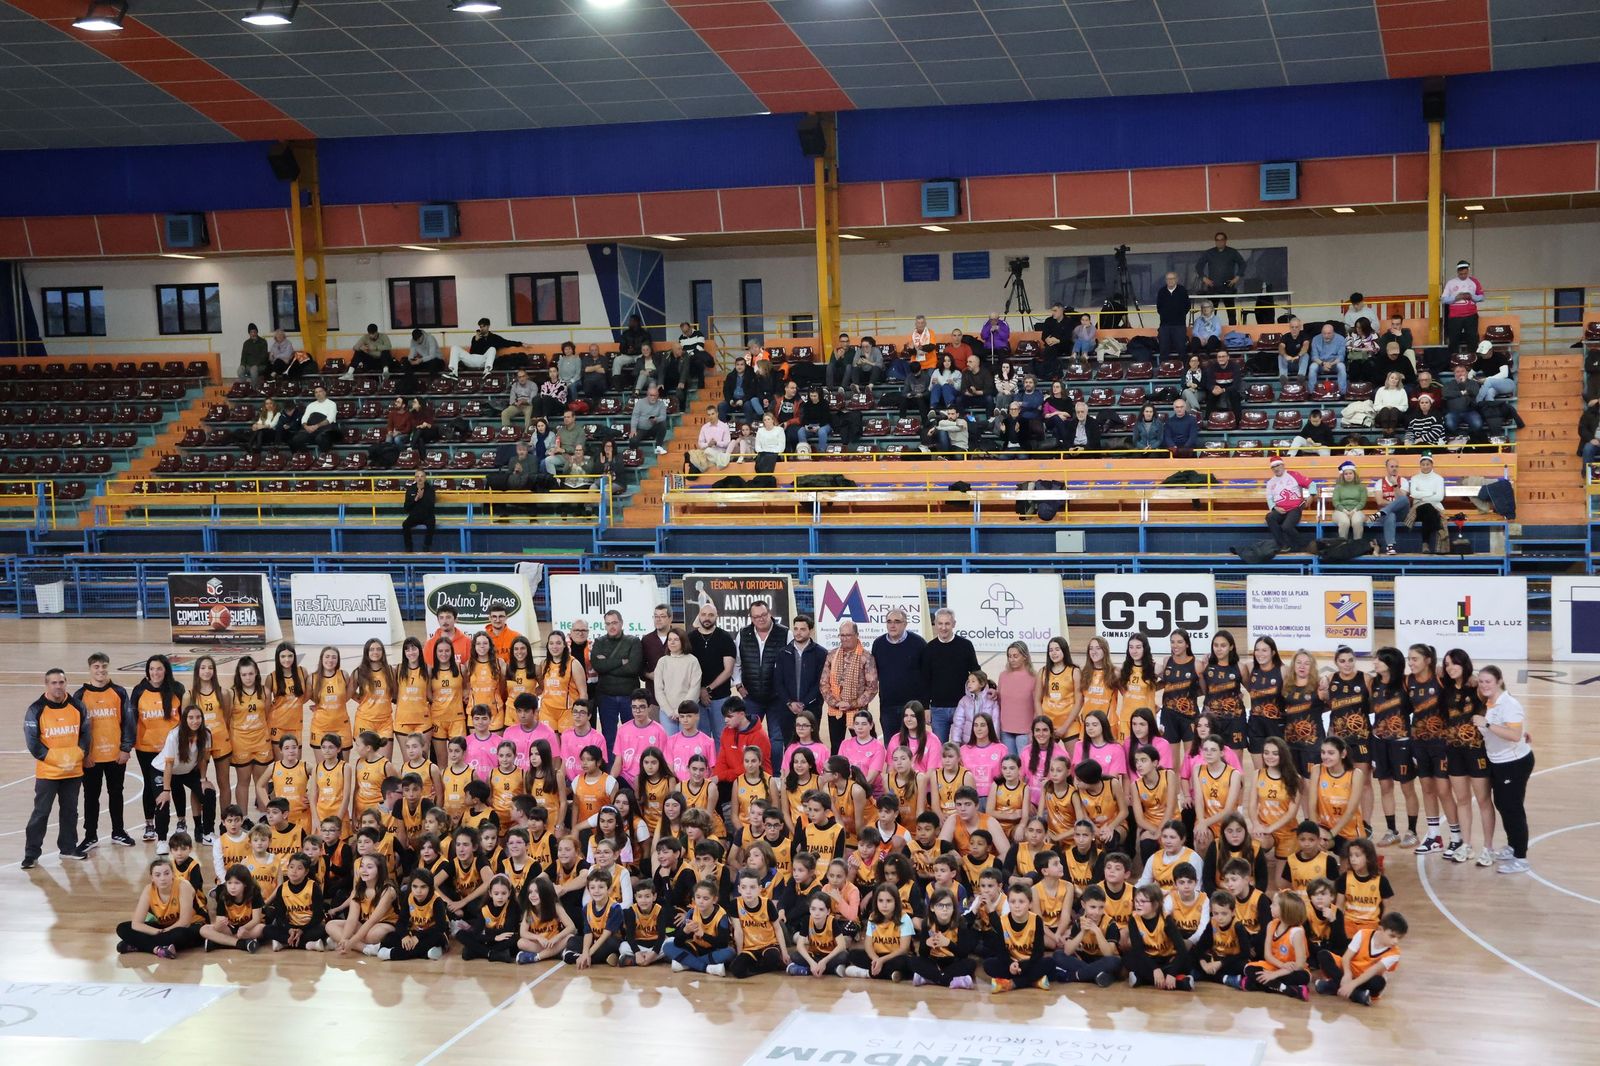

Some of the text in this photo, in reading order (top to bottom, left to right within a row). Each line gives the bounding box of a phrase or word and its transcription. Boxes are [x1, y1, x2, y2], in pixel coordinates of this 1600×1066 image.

[1530, 401, 1556, 410] FILA
[1529, 492, 1556, 500] FILA
[710, 579, 784, 590] TÉCNICA Y ORTOPEDIA
[294, 595, 386, 611] RESTAURANTE
[436, 592, 476, 609] Paulino
[177, 608, 257, 622] COMPITE SUEÑA
[1102, 592, 1208, 638] G3C
[296, 614, 344, 626] MARTA
[629, 622, 646, 631] S.L.
[1019, 627, 1051, 639] salud
[411, 677, 415, 685] 7
[442, 679, 450, 688] 20
[326, 685, 334, 694] 81
[1051, 682, 1059, 691] 26
[204, 703, 213, 712] 73
[248, 704, 257, 712] 24
[86, 708, 117, 719] ZAMARAT
[45, 724, 79, 738] ZAMARAT
[1232, 732, 1243, 743] 24
[1359, 744, 1368, 754] 16
[285, 776, 293, 785] 22
[362, 772, 370, 780] 27
[326, 778, 331, 786] 2
[453, 784, 458, 792] 11
[535, 788, 543, 797] 62
[1268, 789, 1277, 799] 23
[1333, 806, 1342, 816] 32
[1177, 920, 1199, 928] AMAR
[963, 1035, 1133, 1051] DACSA GROUP
[866, 1038, 1129, 1063] INGREDIENTS
